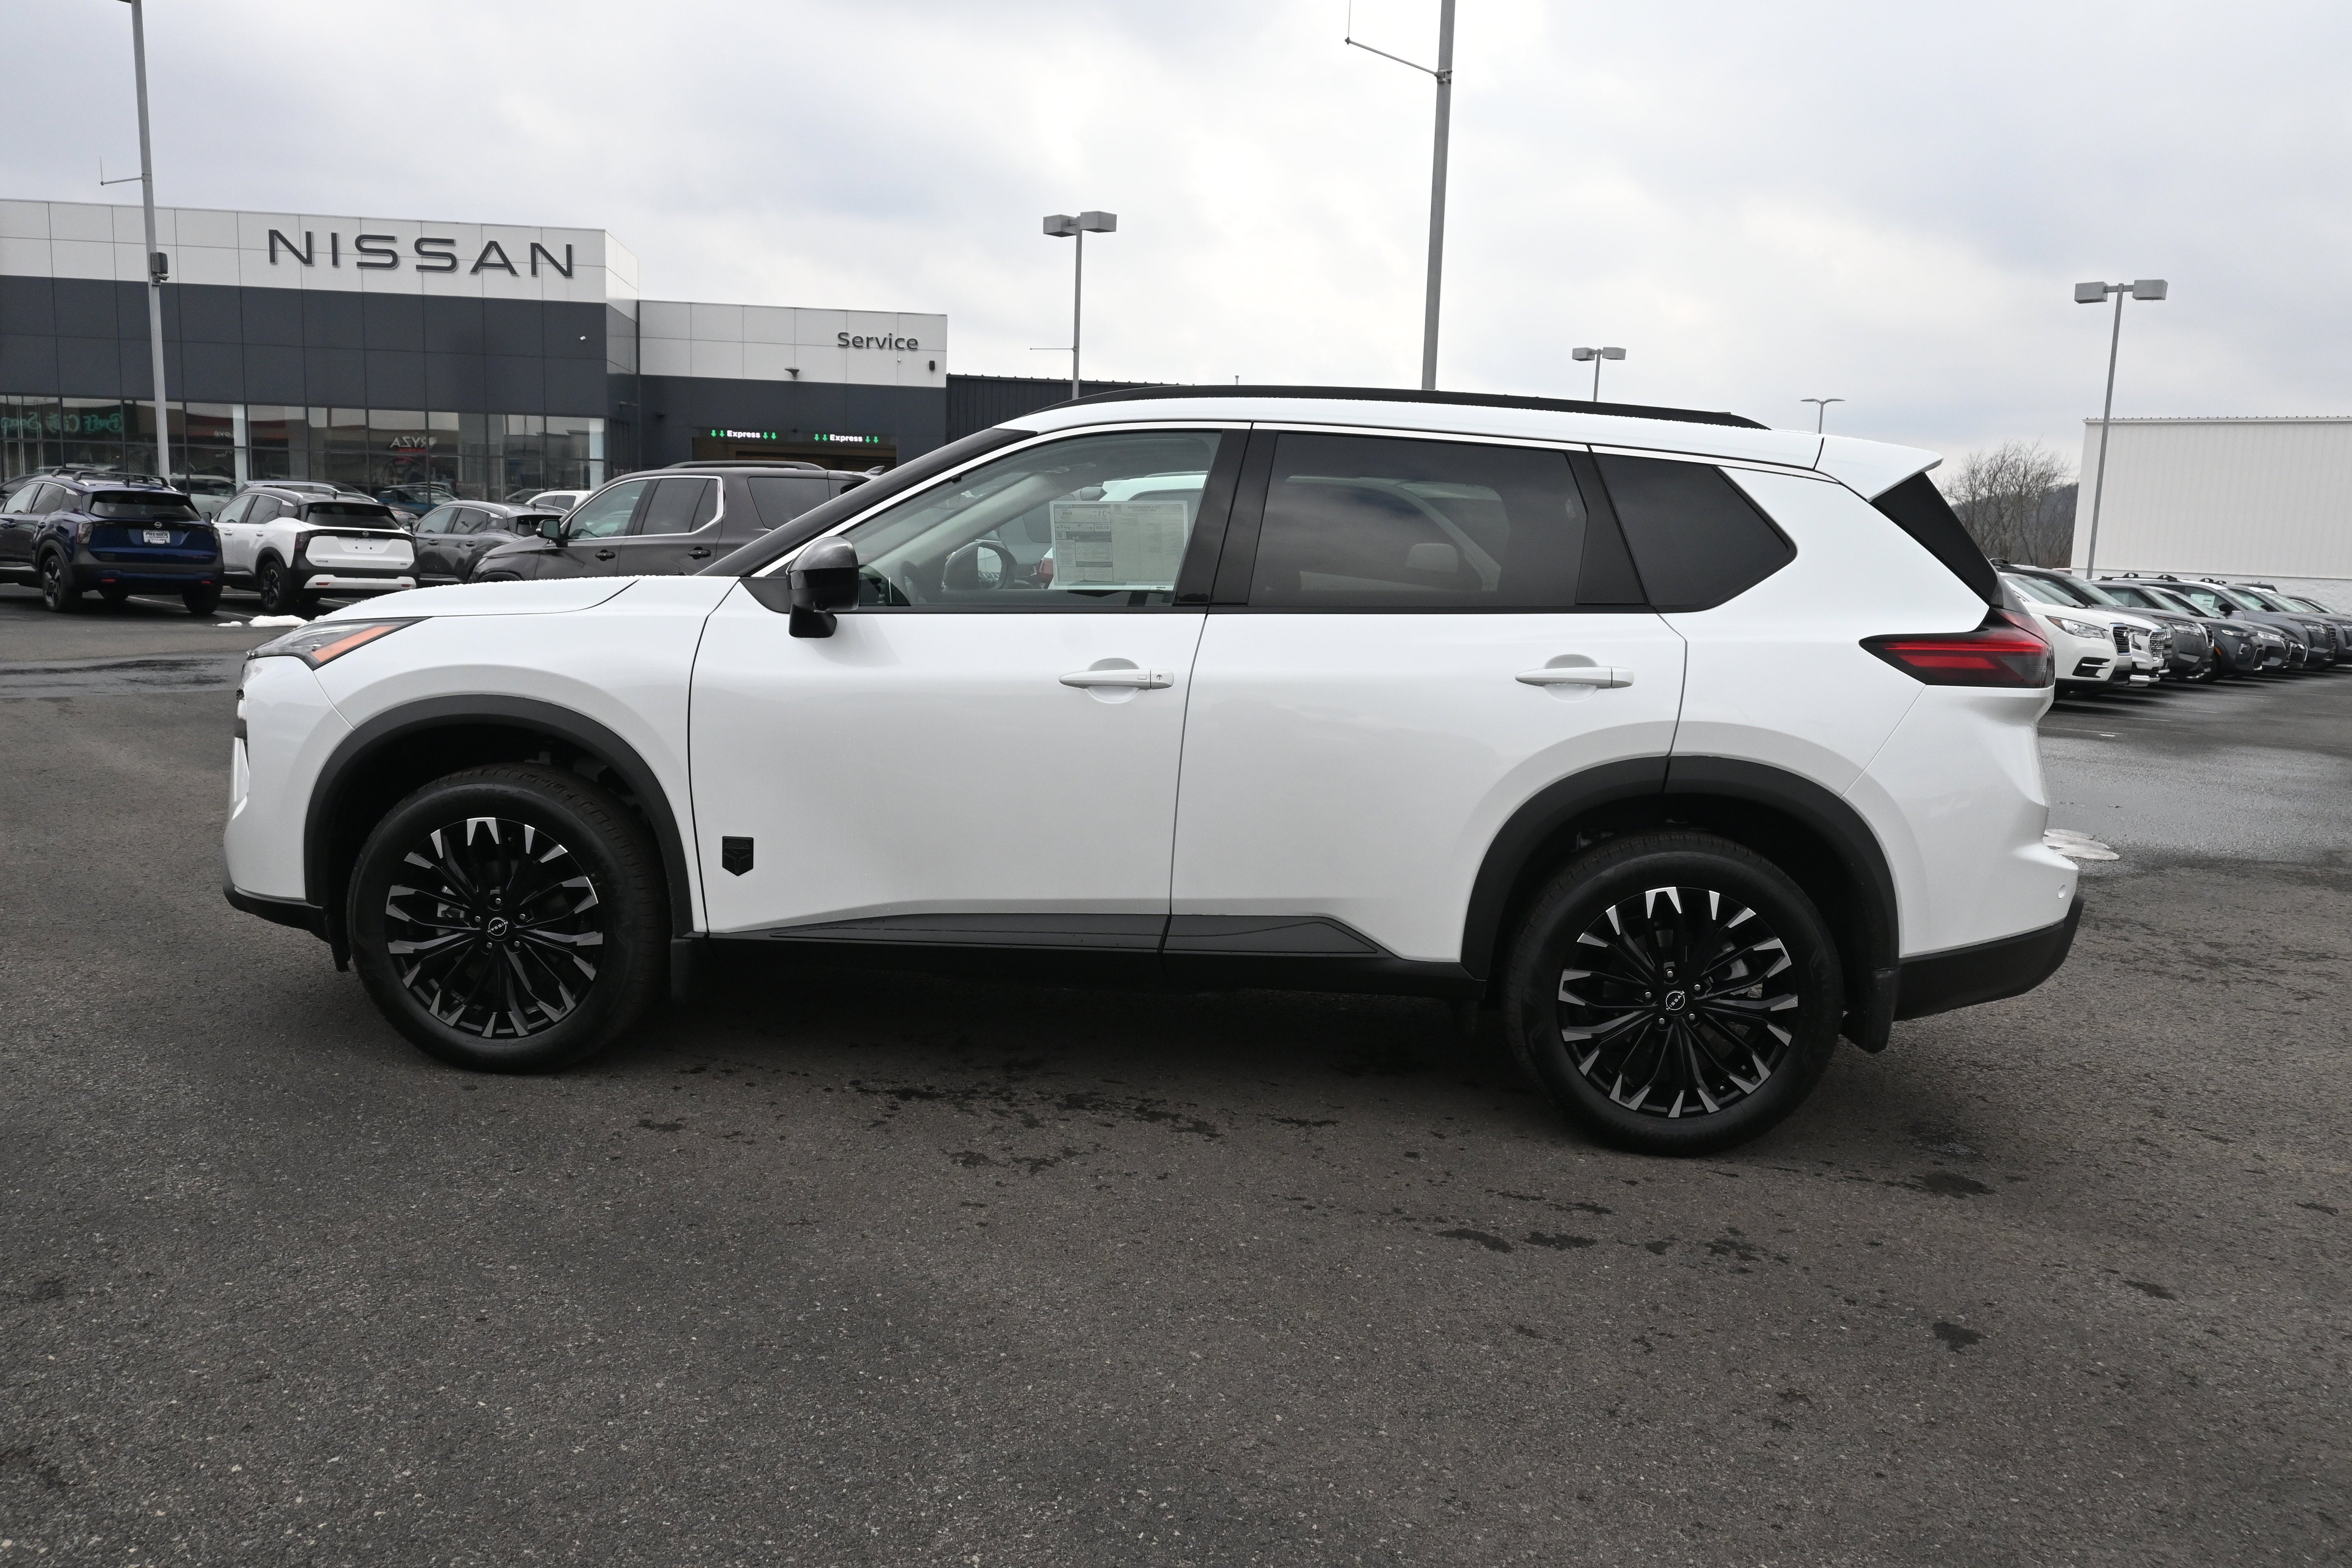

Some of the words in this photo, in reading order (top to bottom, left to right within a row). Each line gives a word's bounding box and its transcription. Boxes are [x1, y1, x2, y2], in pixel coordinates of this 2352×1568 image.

[269, 229, 574, 277] NISSAN
[837, 332, 919, 351] Service
[727, 430, 761, 438] Express
[830, 434, 863, 442] Express
[487, 921, 508, 933] NISSAN
[1666, 991, 1685, 1011] NISSAN
